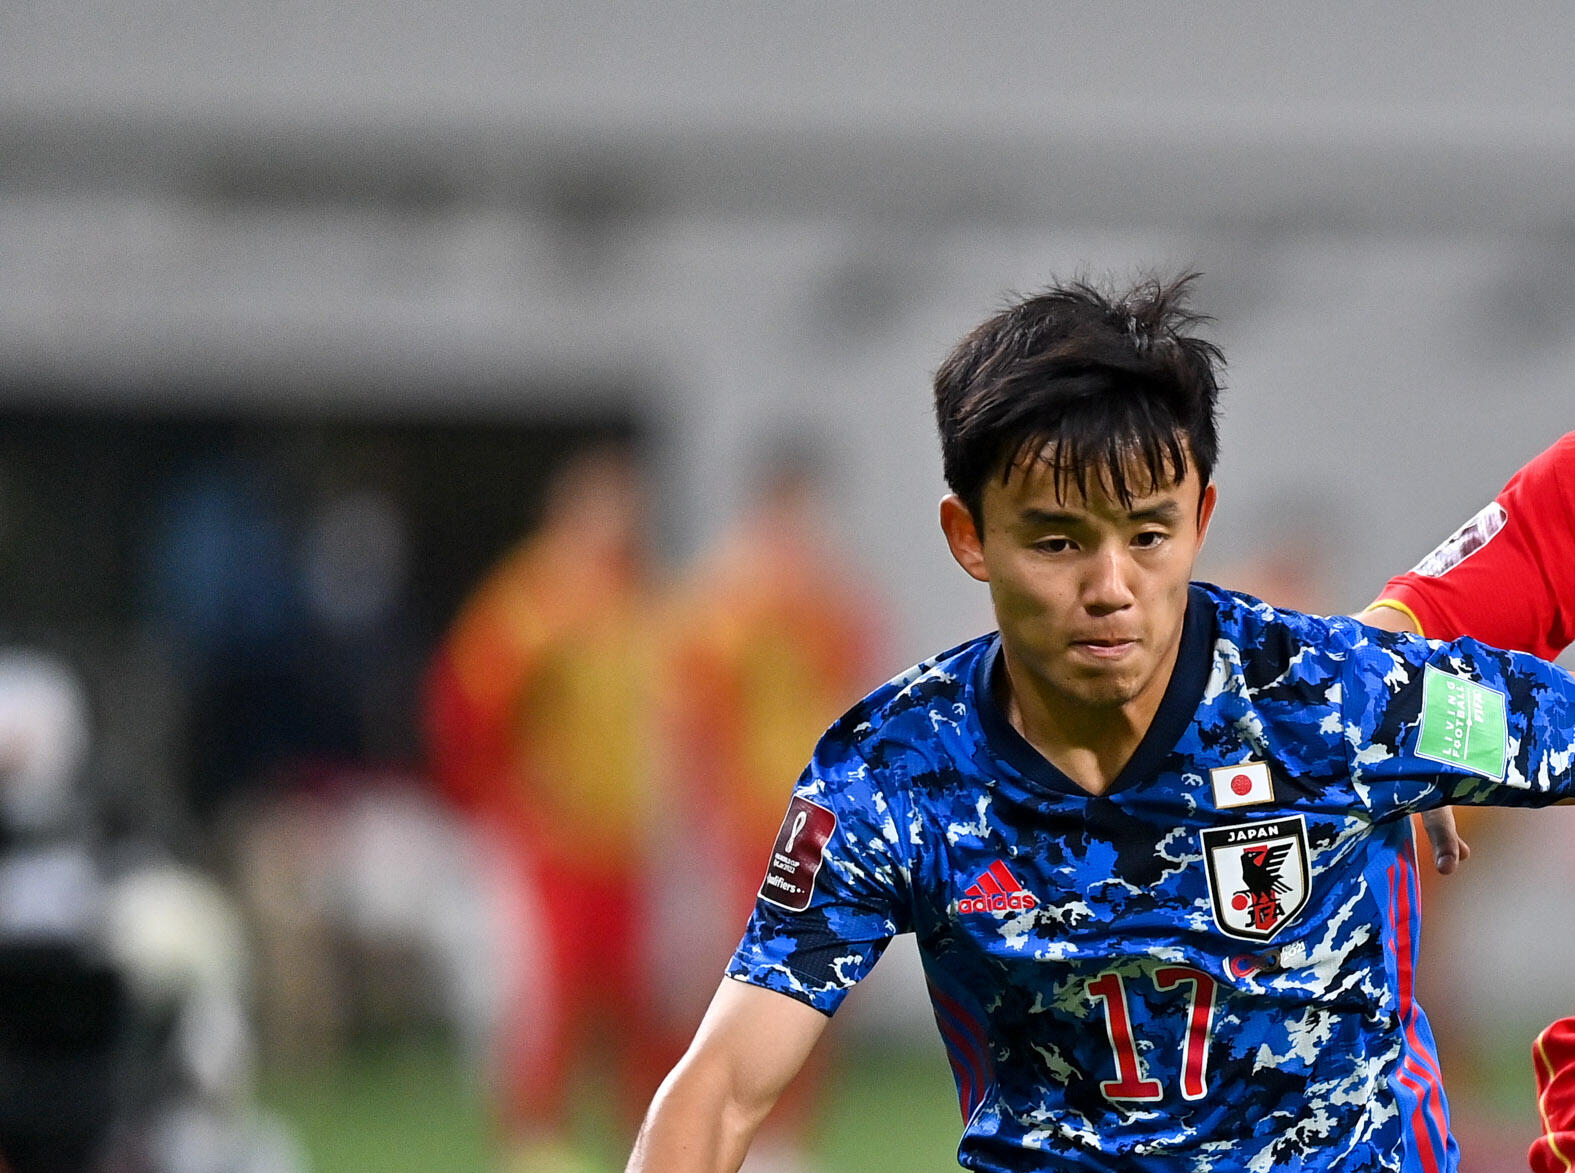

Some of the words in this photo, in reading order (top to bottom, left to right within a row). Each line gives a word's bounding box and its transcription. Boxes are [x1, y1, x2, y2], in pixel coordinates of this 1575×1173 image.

[1442, 681, 1457, 756] LIVING
[1452, 685, 1467, 758] FOOTBALL
[1227, 825, 1280, 843] JAPAN
[957, 891, 1036, 914] adidas
[1245, 904, 1286, 928] JFA
[1084, 966, 1218, 1101] 17
